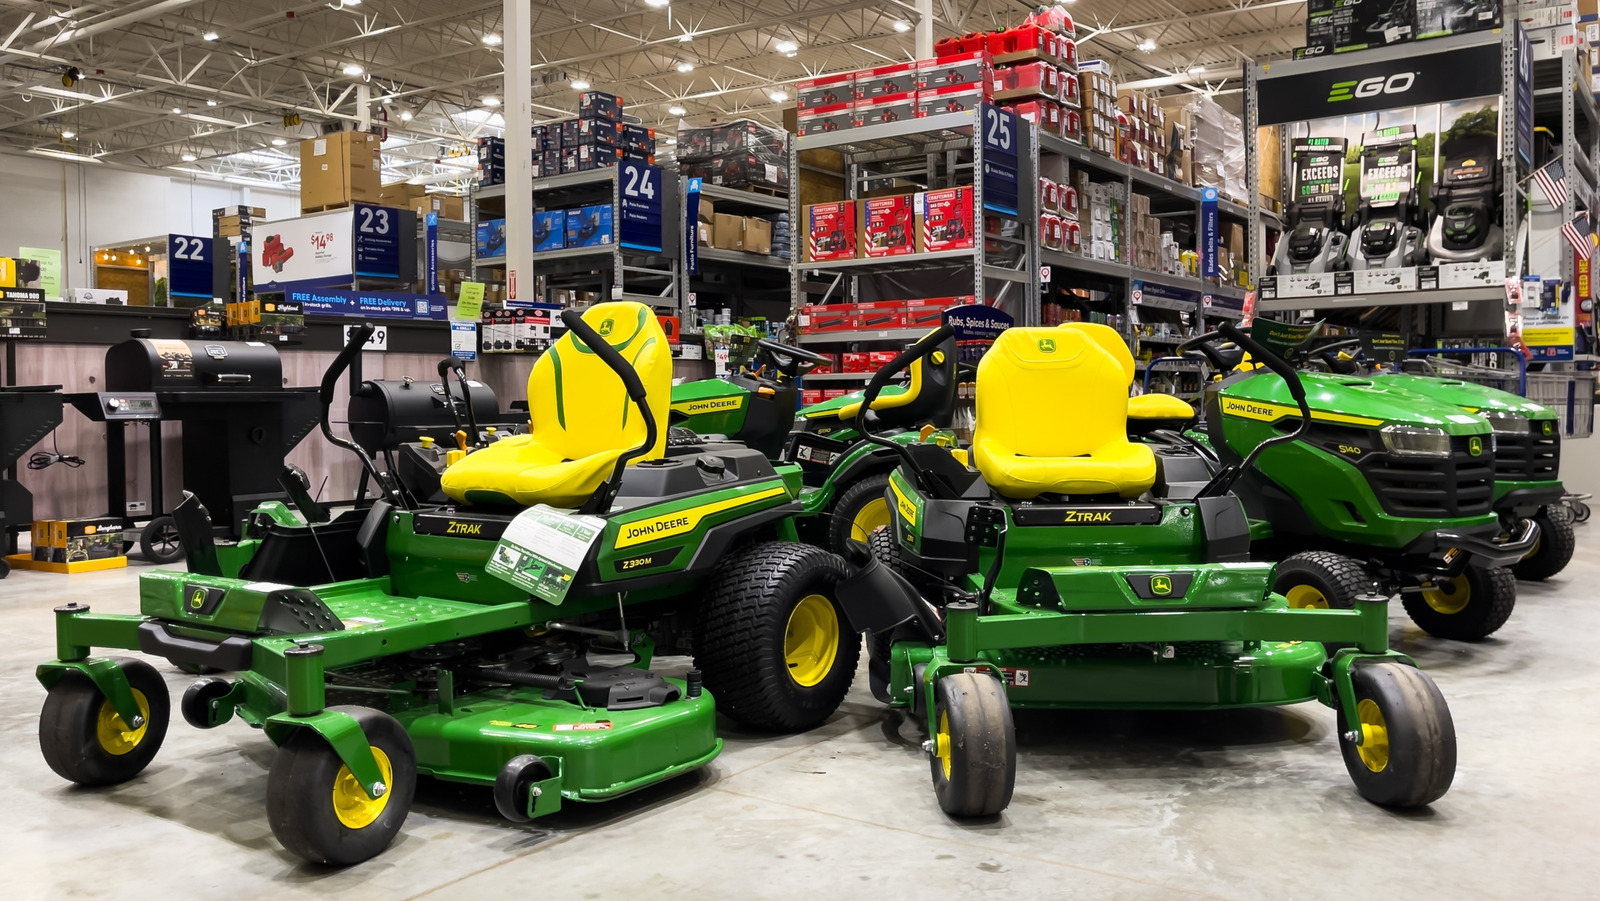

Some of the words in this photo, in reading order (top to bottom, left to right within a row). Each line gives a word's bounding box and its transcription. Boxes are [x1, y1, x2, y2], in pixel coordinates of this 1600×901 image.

[1296, 46, 1324, 56] EGO
[1520, 30, 1528, 82] 26
[1327, 72, 1415, 102] EGO
[988, 108, 1010, 150] 25
[1302, 166, 1338, 181] EXCEEDS
[1368, 165, 1408, 180] EXCEEDS
[625, 166, 654, 199] 24
[1302, 185, 1310, 195] 60
[360, 207, 389, 234] 23
[174, 237, 204, 261] 22
[1579, 259, 1588, 273] HE
[292, 292, 310, 301] FREE
[312, 294, 346, 304] Assembly
[378, 298, 407, 307] Delivery
[948, 315, 965, 328] Rubs,
[966, 317, 984, 328] Spices
[985, 318, 990, 328] &
[991, 320, 1009, 329] Sauces
[710, 400, 737, 408] DEERE
[1226, 402, 1245, 411] JOHN
[1247, 404, 1273, 416] DEERE
[1338, 444, 1361, 454] S140
[1064, 511, 1112, 522] ZTRAK
[447, 521, 482, 535] ZTRAK
[626, 524, 654, 539] JOHN
[656, 517, 689, 532] DEERE
[622, 557, 652, 569] Z330M
